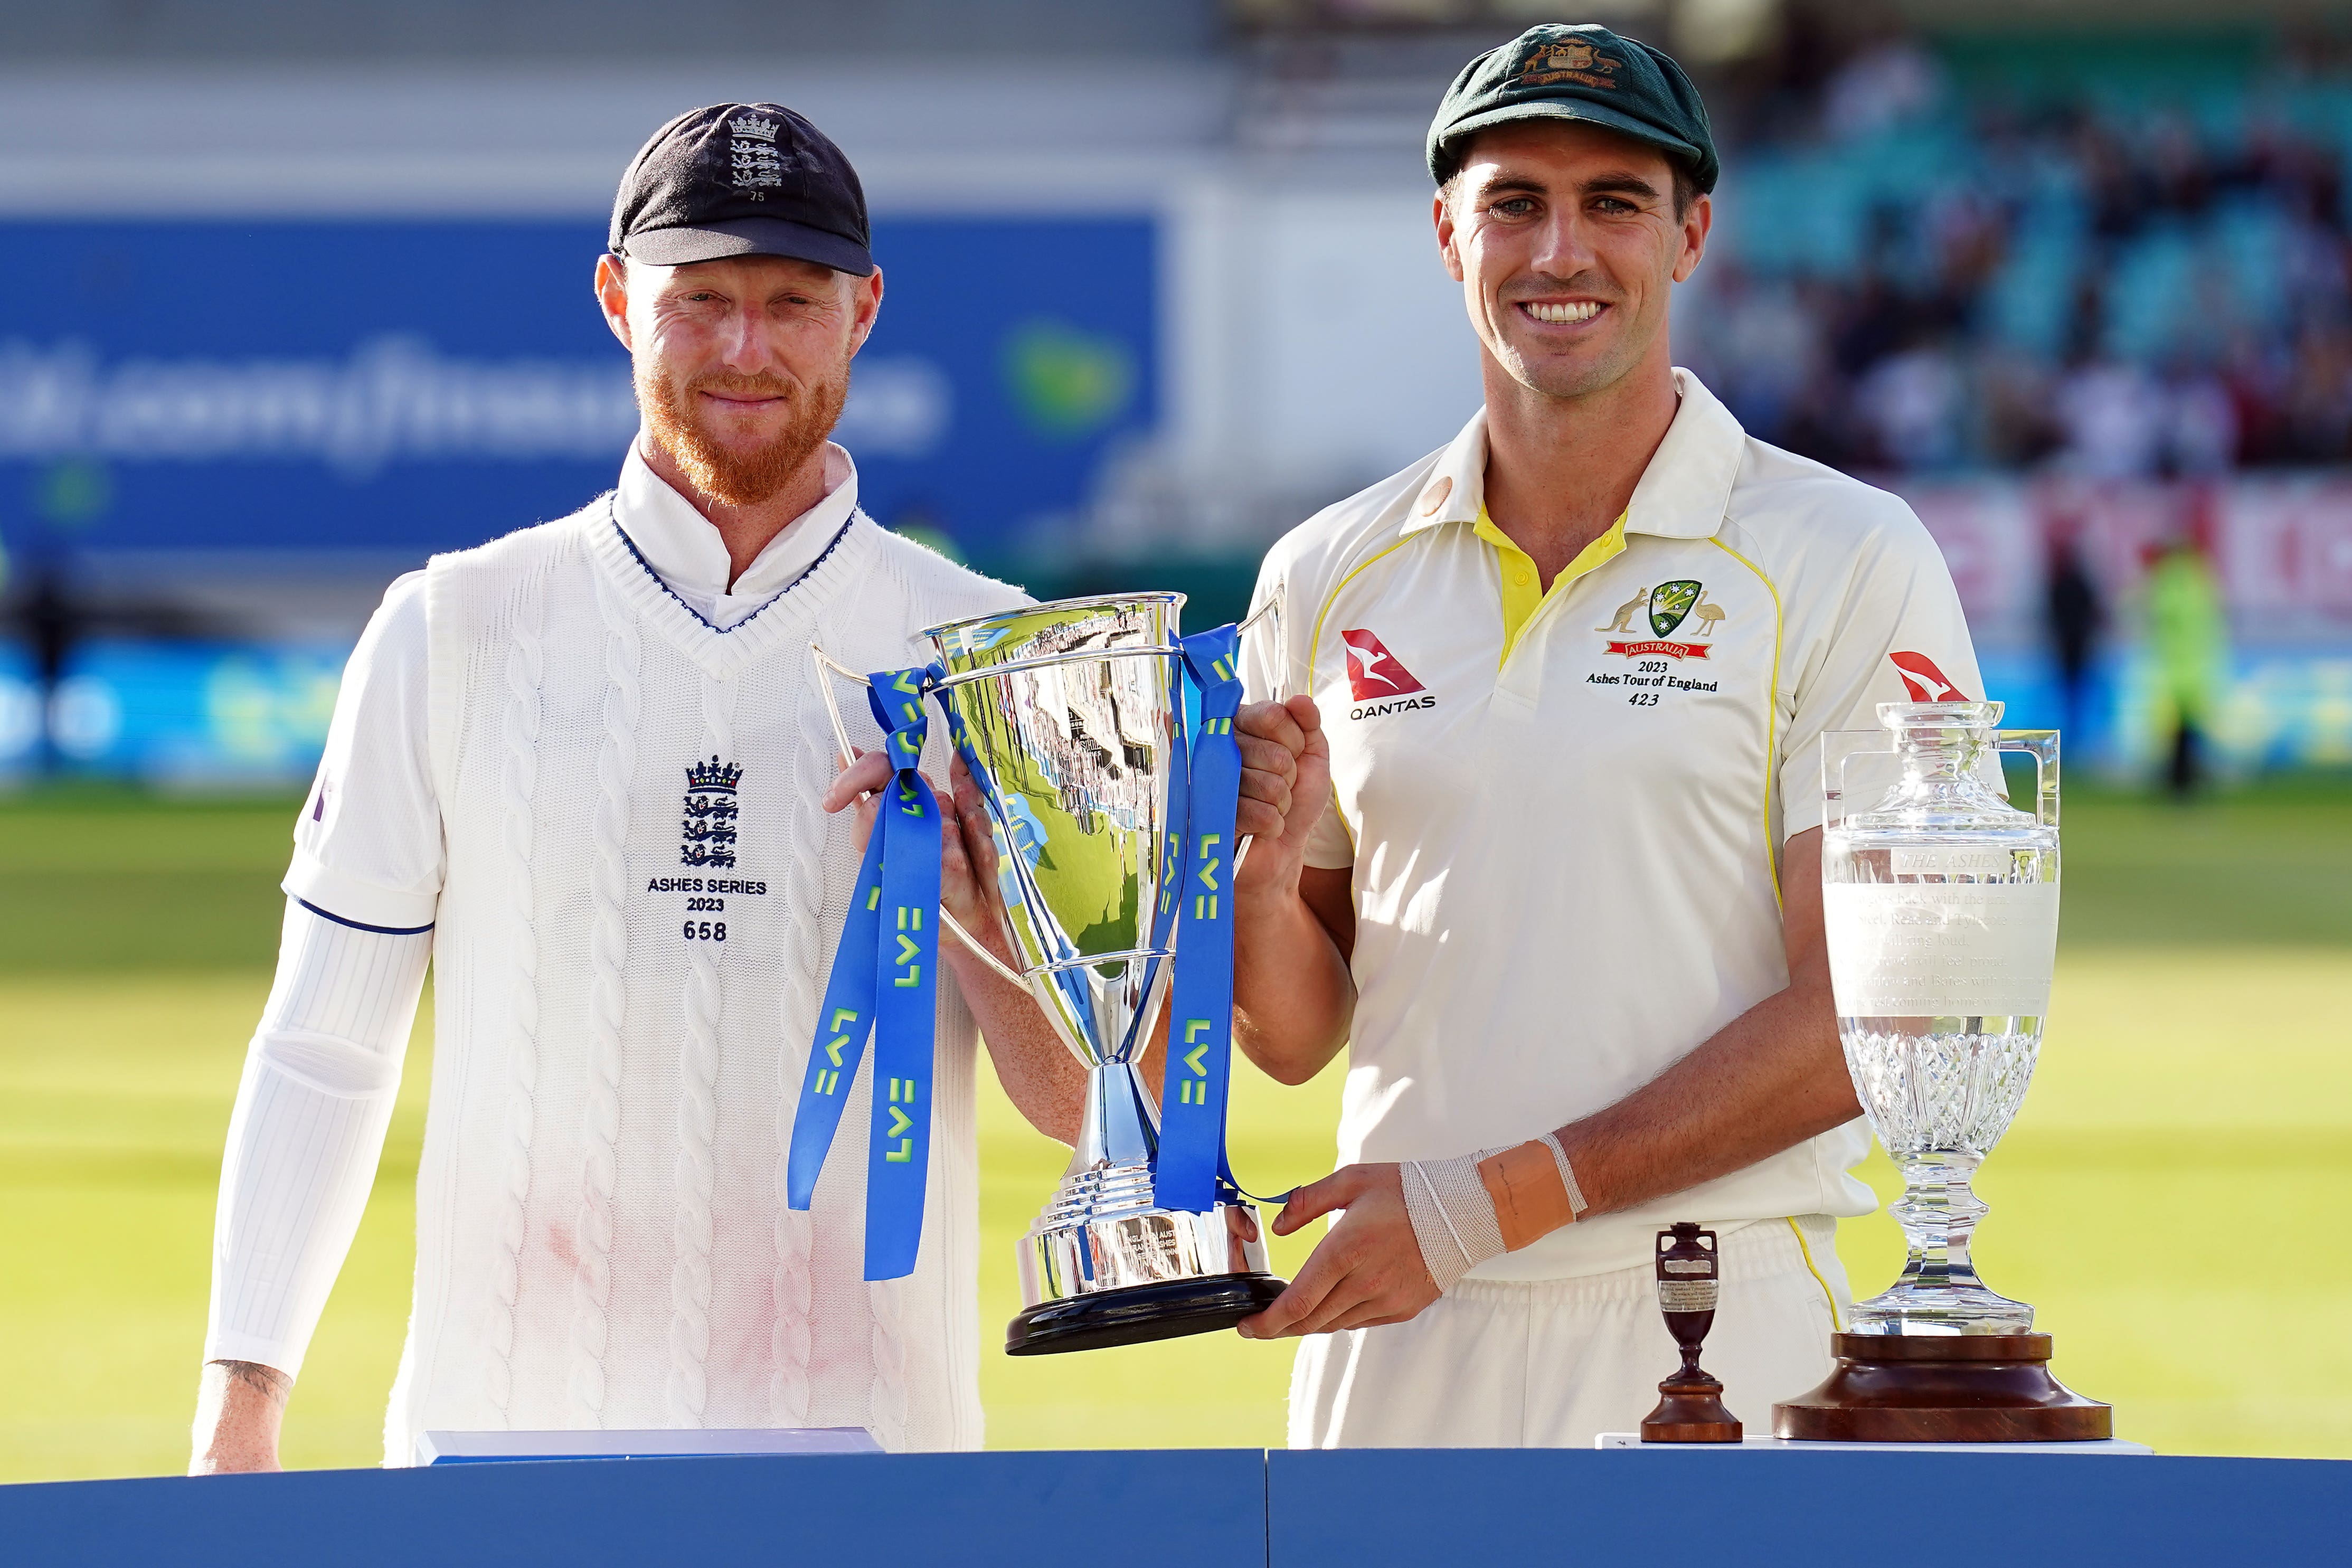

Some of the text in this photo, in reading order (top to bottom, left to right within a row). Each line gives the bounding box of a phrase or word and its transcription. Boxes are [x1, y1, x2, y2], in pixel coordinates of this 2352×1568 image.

[750, 191, 764, 202] 75
[1628, 643, 1684, 658] AUSTRALIA
[1638, 661, 1668, 673] 2023
[1586, 673, 1718, 692] Ashes Tour of England
[1629, 693, 1659, 706] 423
[1350, 696, 1435, 720] QANTAS
[1902, 853, 2000, 868] THE ASHES
[648, 878, 767, 895] ASHES SERIES
[687, 898, 724, 912] 2023
[1898, 893, 1926, 904] back
[1932, 892, 1959, 904] with
[1964, 893, 1983, 904] the
[1925, 913, 1949, 925] and
[684, 920, 726, 941] 658
[1907, 934, 1932, 948] ring
[1913, 953, 1937, 966] will
[1942, 953, 1964, 966] feel
[1904, 976, 1926, 987] and
[1932, 974, 1967, 987] Bates
[1971, 974, 1997, 987] with
[1893, 994, 1939, 1009] coming
[1943, 995, 1979, 1007] home
